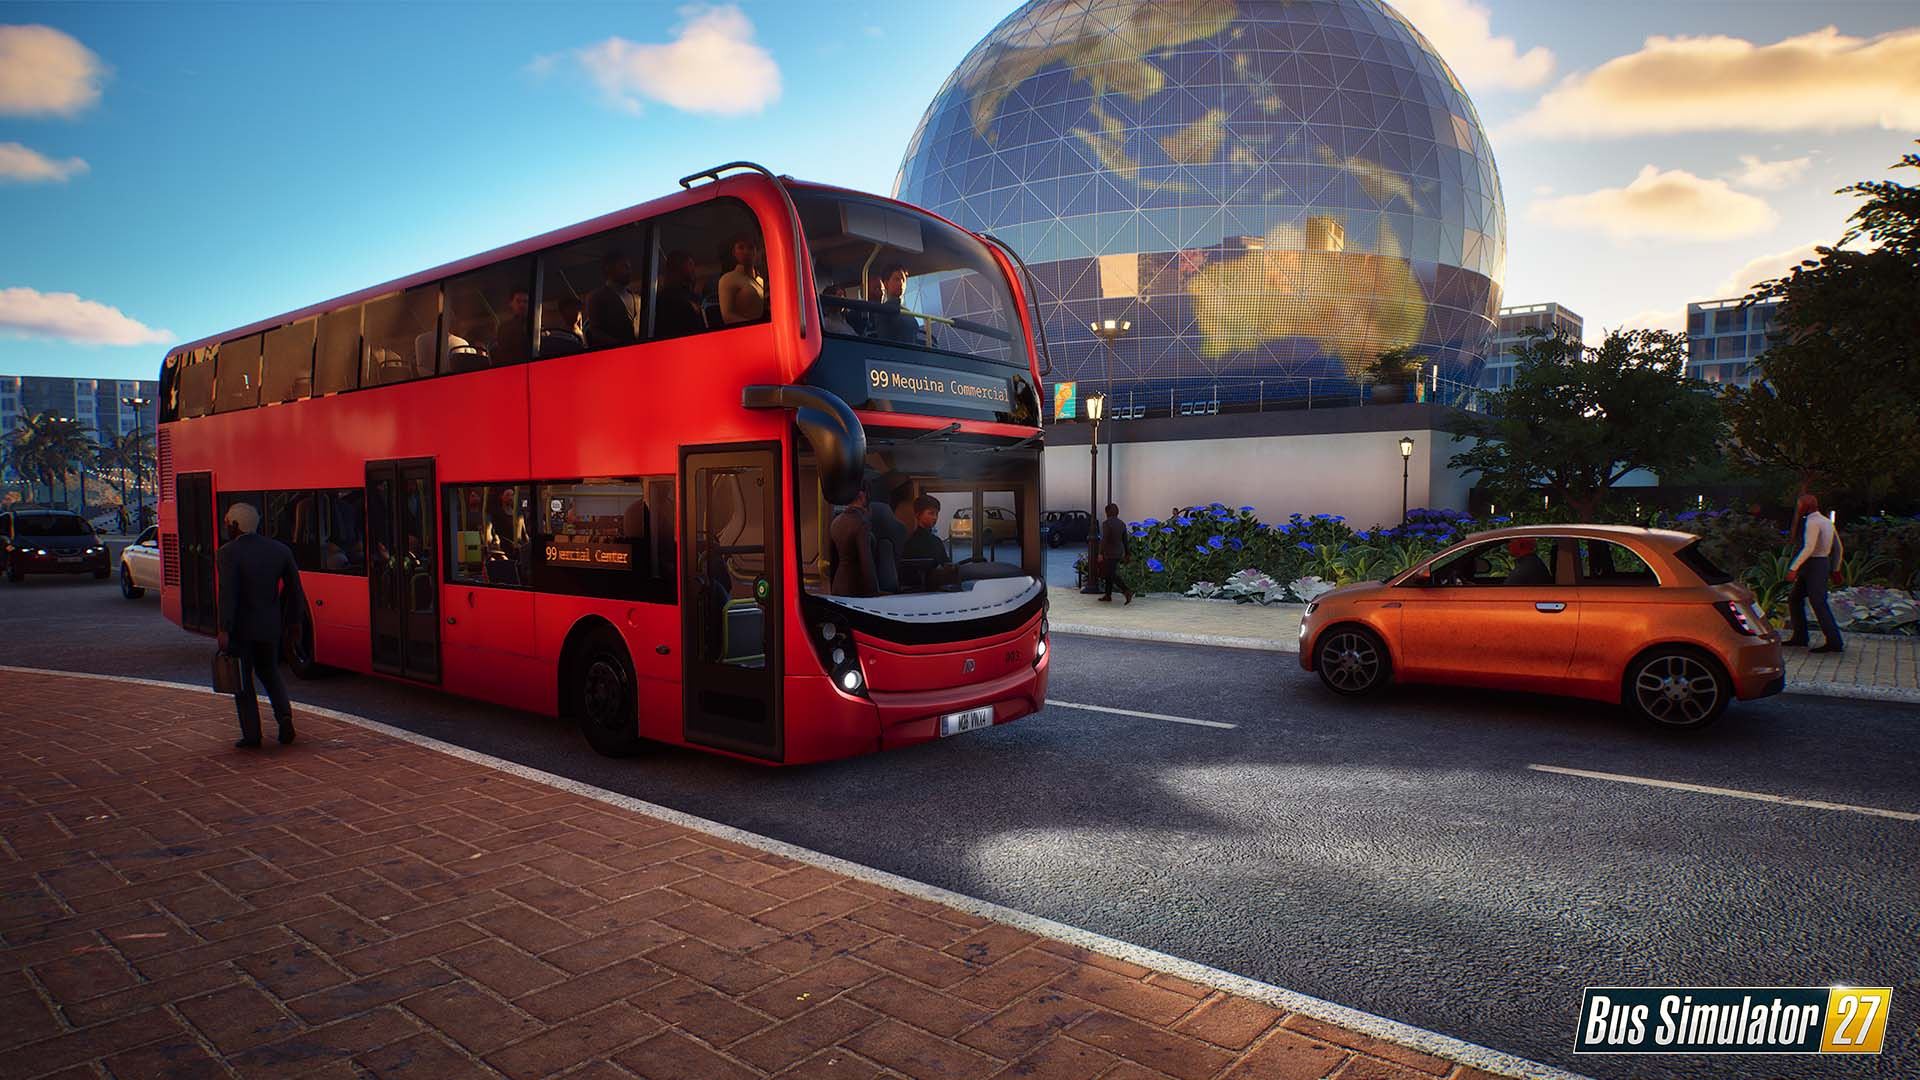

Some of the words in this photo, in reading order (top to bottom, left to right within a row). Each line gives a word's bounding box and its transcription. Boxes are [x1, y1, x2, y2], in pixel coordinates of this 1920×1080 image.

[870, 369, 889, 388] 99
[891, 373, 944, 394] Mequina
[950, 380, 1009, 402] Commercial
[545, 546, 558, 561] 99
